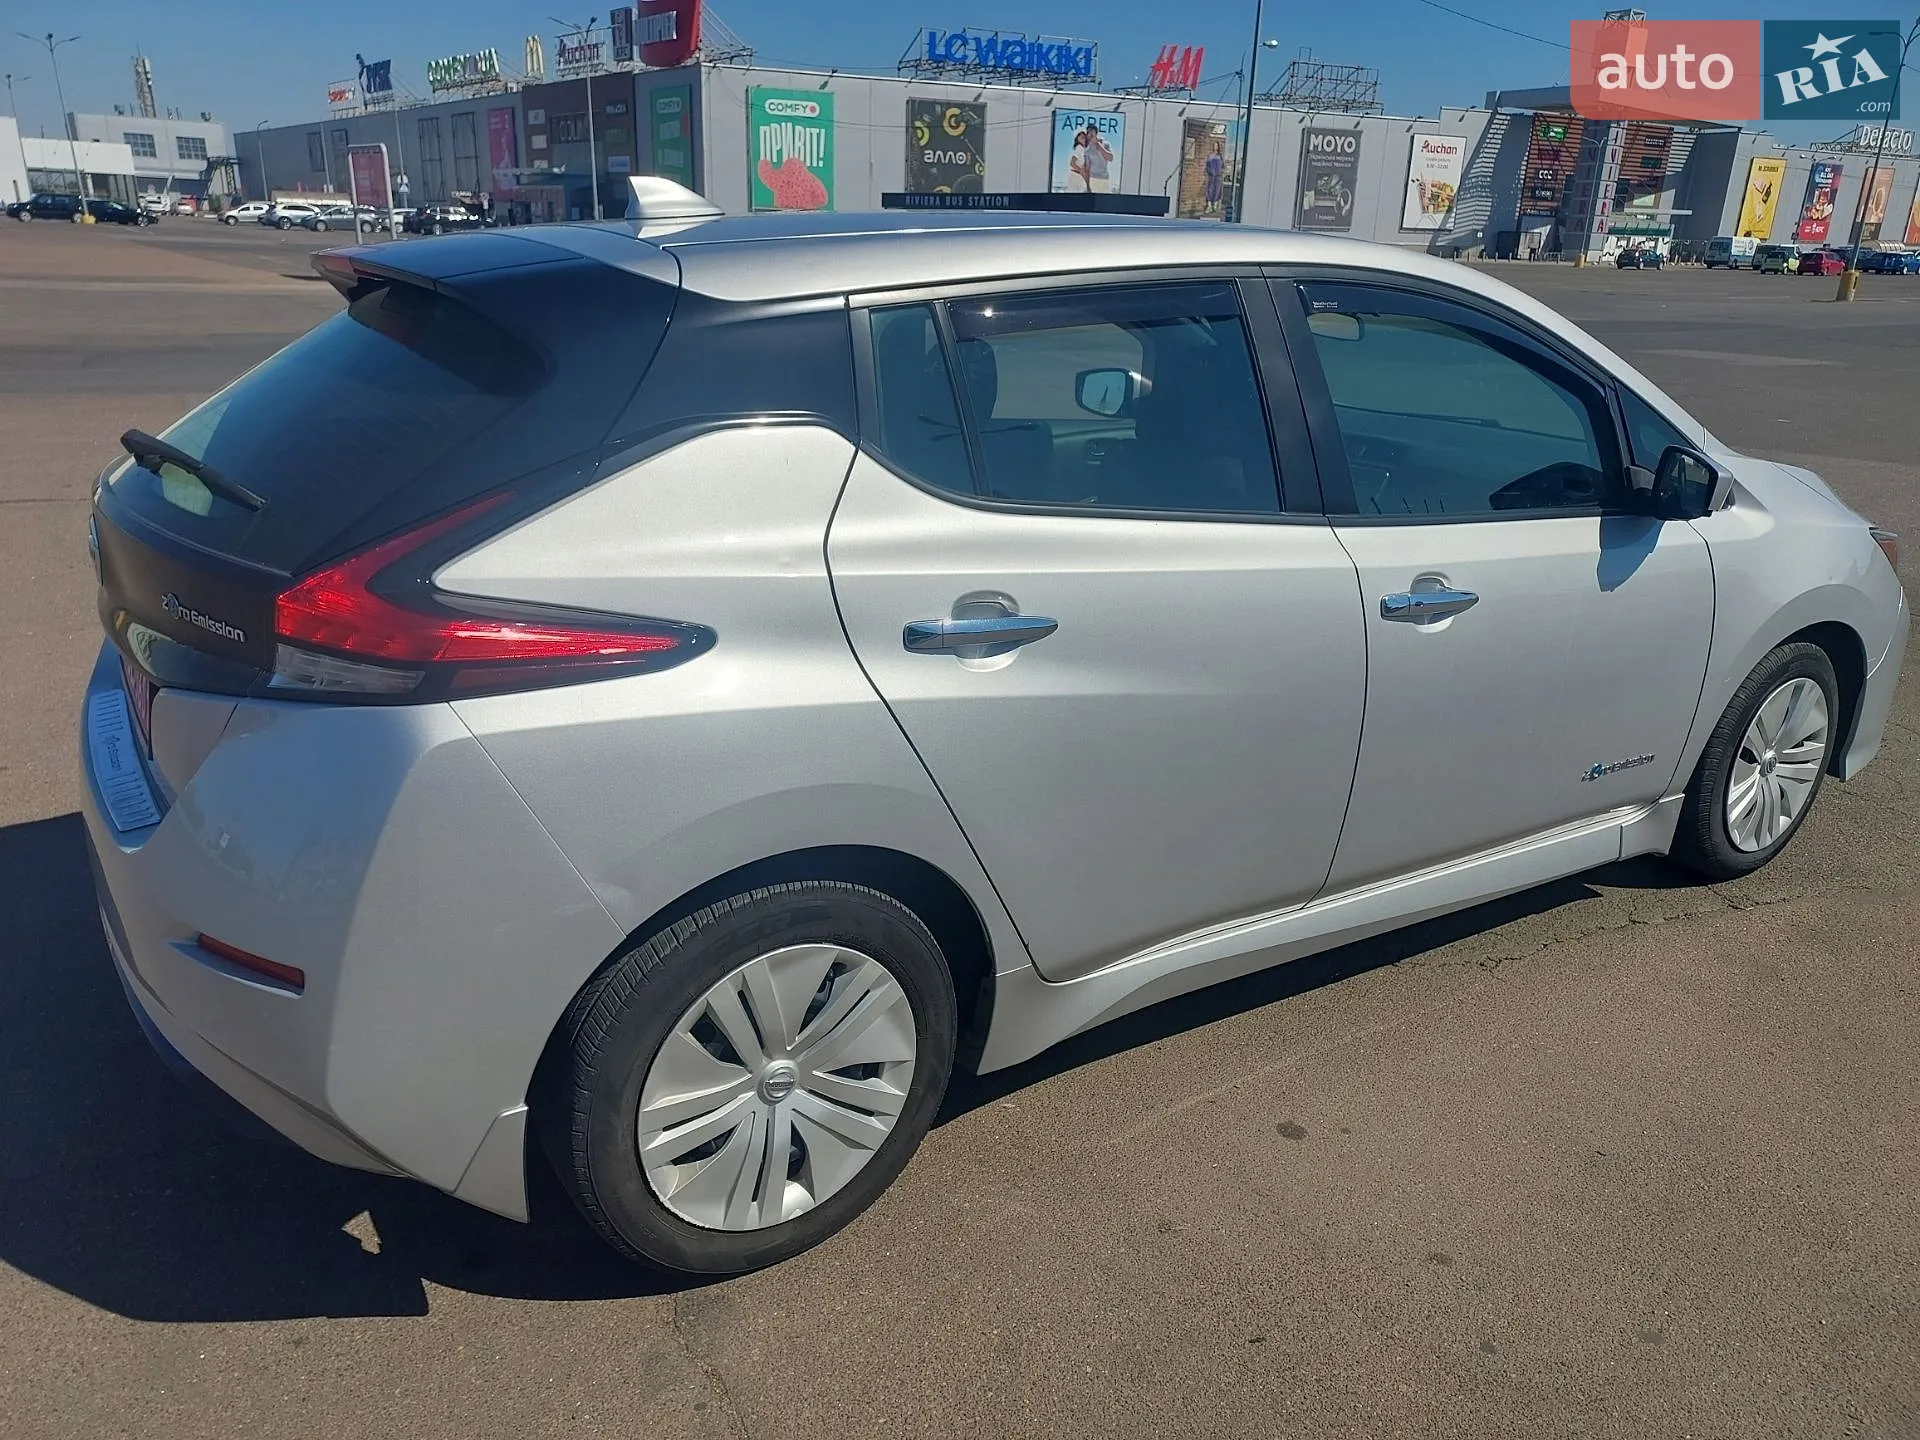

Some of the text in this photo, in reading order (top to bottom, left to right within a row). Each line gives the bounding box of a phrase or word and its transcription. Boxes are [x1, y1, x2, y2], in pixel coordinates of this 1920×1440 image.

[928, 31, 968, 62] LC
[1150, 44, 1204, 91] H&M
[768, 102, 808, 113] COMFY
[759, 121, 826, 167] ПРИВІТ!
[1309, 133, 1356, 153] MOYO
[1421, 139, 1458, 155] Auchan
[905, 195, 1010, 207] RIVIERA BUS STATION
